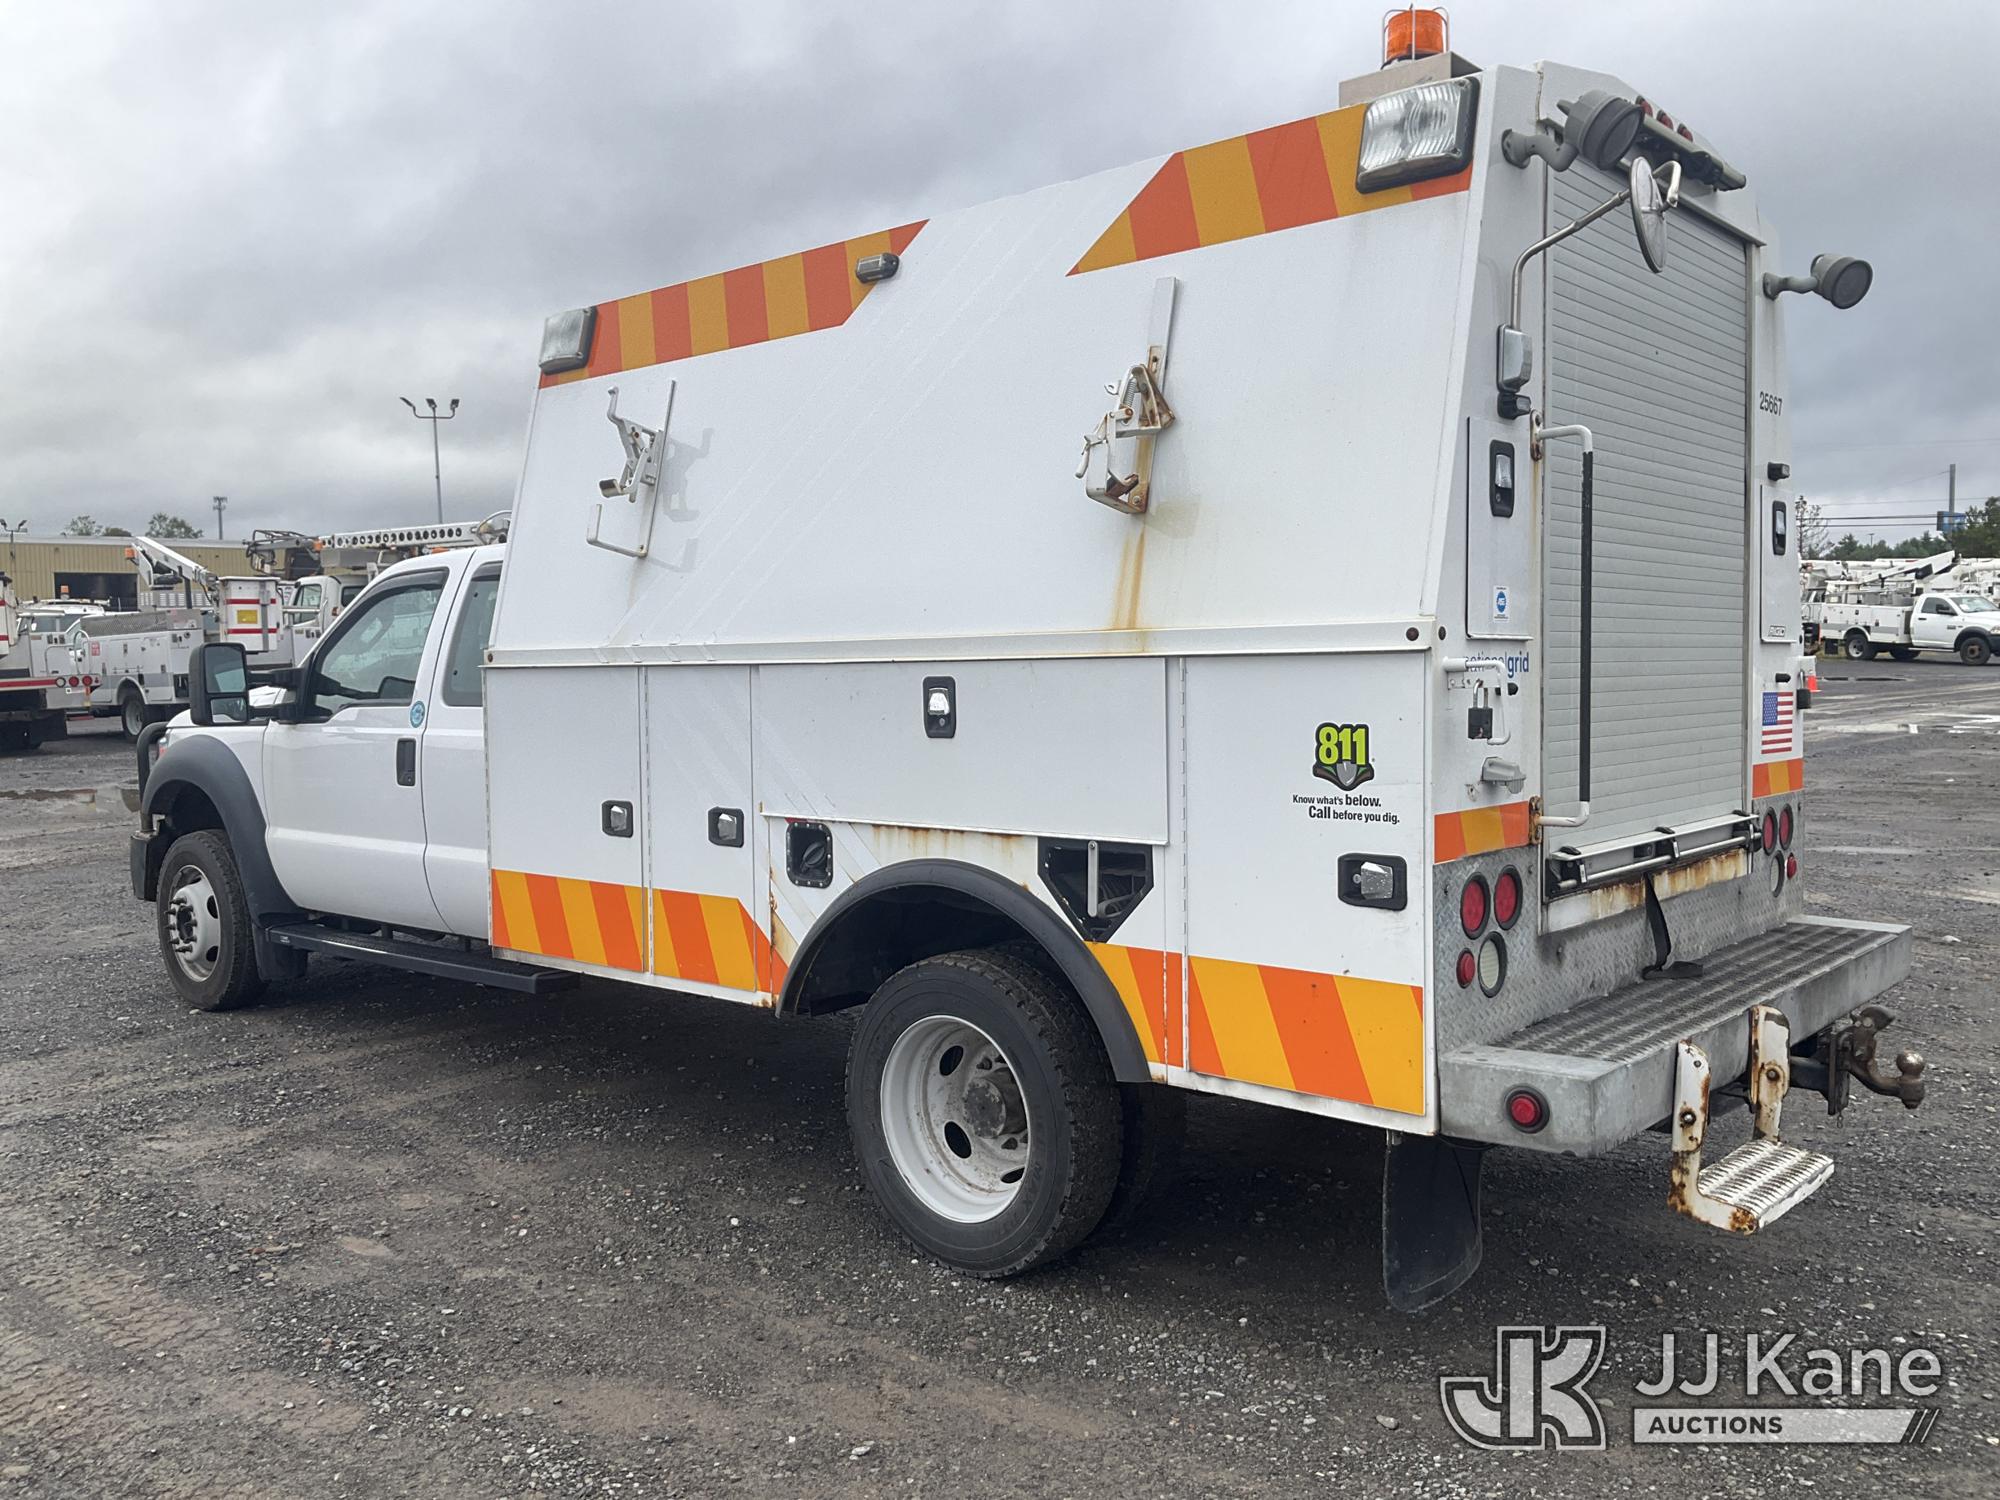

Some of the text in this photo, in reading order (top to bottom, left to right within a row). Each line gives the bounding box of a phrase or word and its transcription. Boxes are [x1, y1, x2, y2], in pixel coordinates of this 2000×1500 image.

[1759, 391, 1783, 417] 25667
[1317, 724, 1367, 767] 811
[1292, 794, 1382, 807] Know what's below.
[1308, 806, 1400, 825] Call before you dig.
